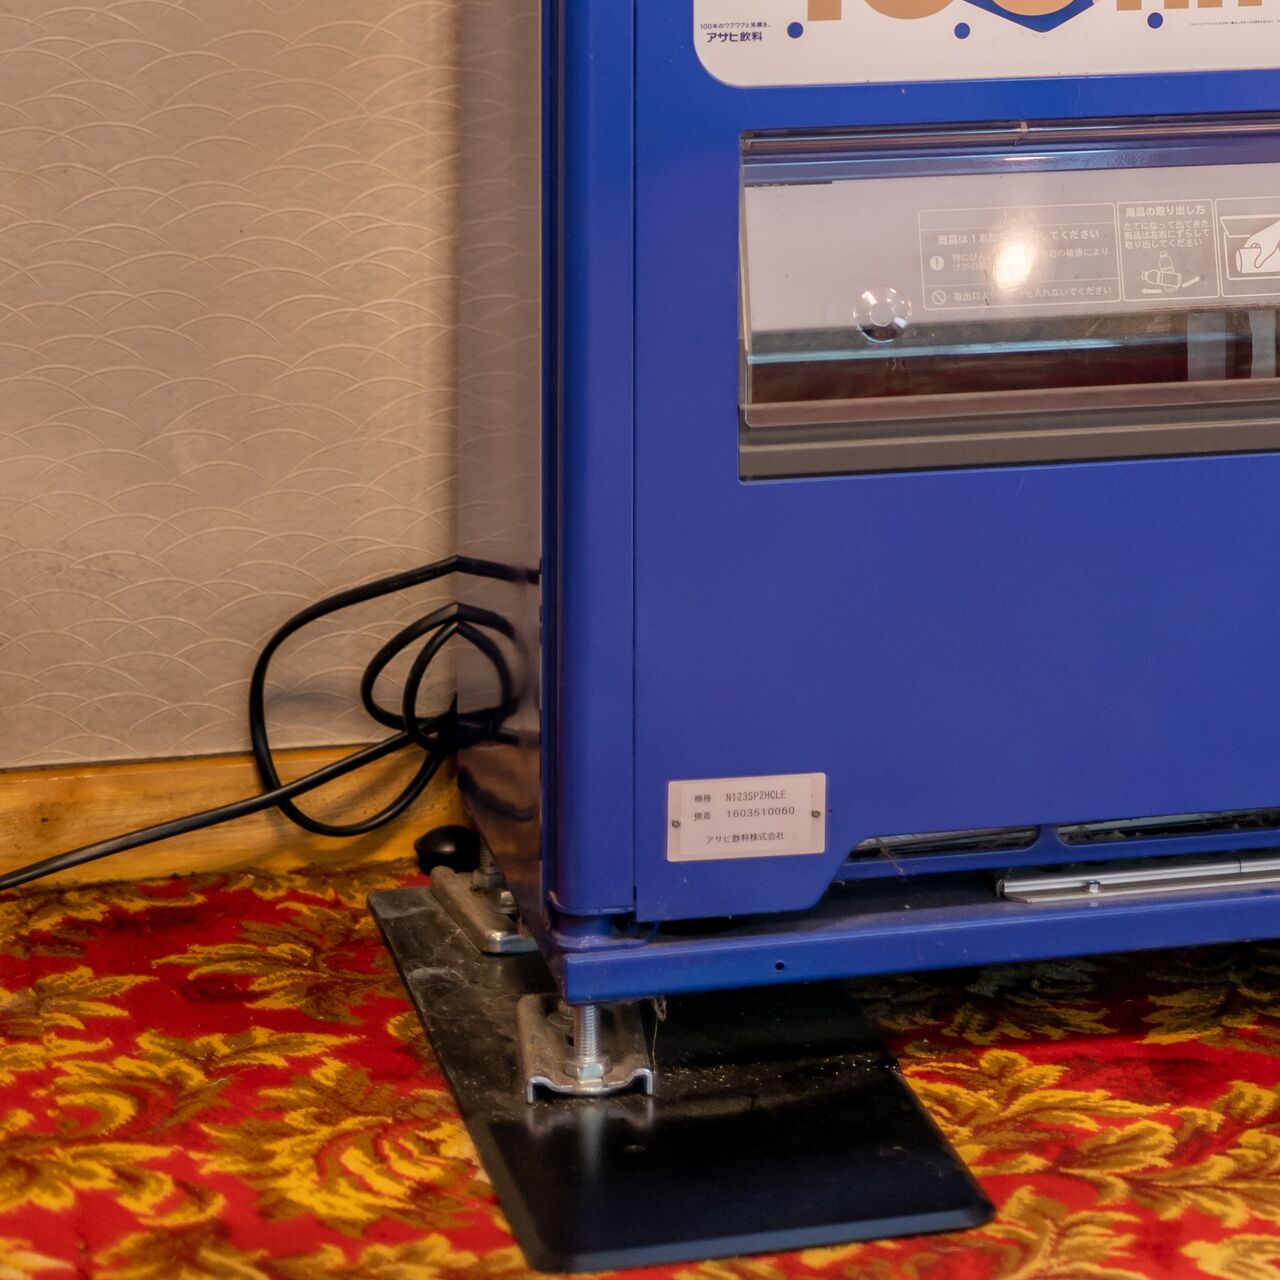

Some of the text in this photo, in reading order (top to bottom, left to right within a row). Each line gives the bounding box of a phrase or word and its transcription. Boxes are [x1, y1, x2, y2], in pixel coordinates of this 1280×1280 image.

[706, 31, 763, 43] アサヒ飲料
[1126, 206, 1206, 218] 商品の取り出し方
